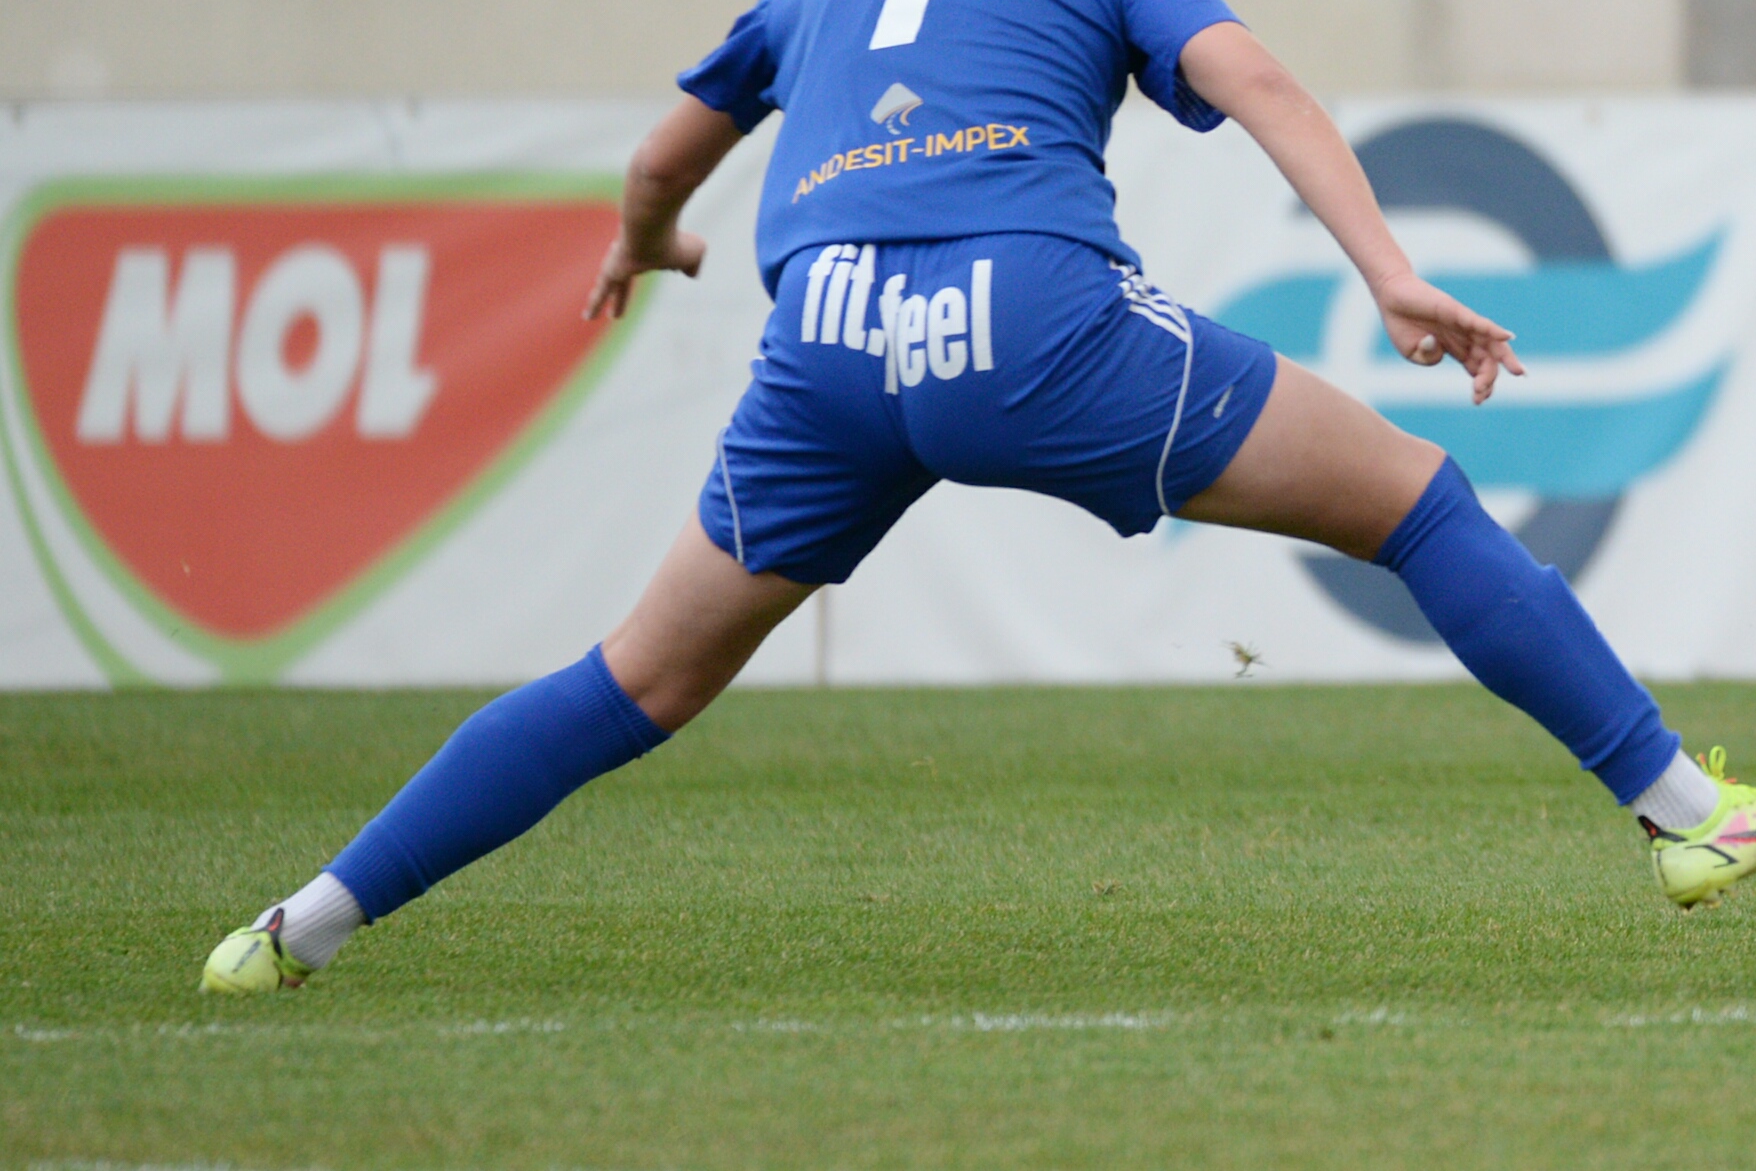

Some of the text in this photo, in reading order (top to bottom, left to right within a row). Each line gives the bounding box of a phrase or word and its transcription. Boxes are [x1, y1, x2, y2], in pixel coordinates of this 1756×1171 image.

[791, 123, 1031, 204] ANDESIT-IMPEX
[75, 240, 439, 444] MOL
[800, 243, 994, 396] fit.feel
